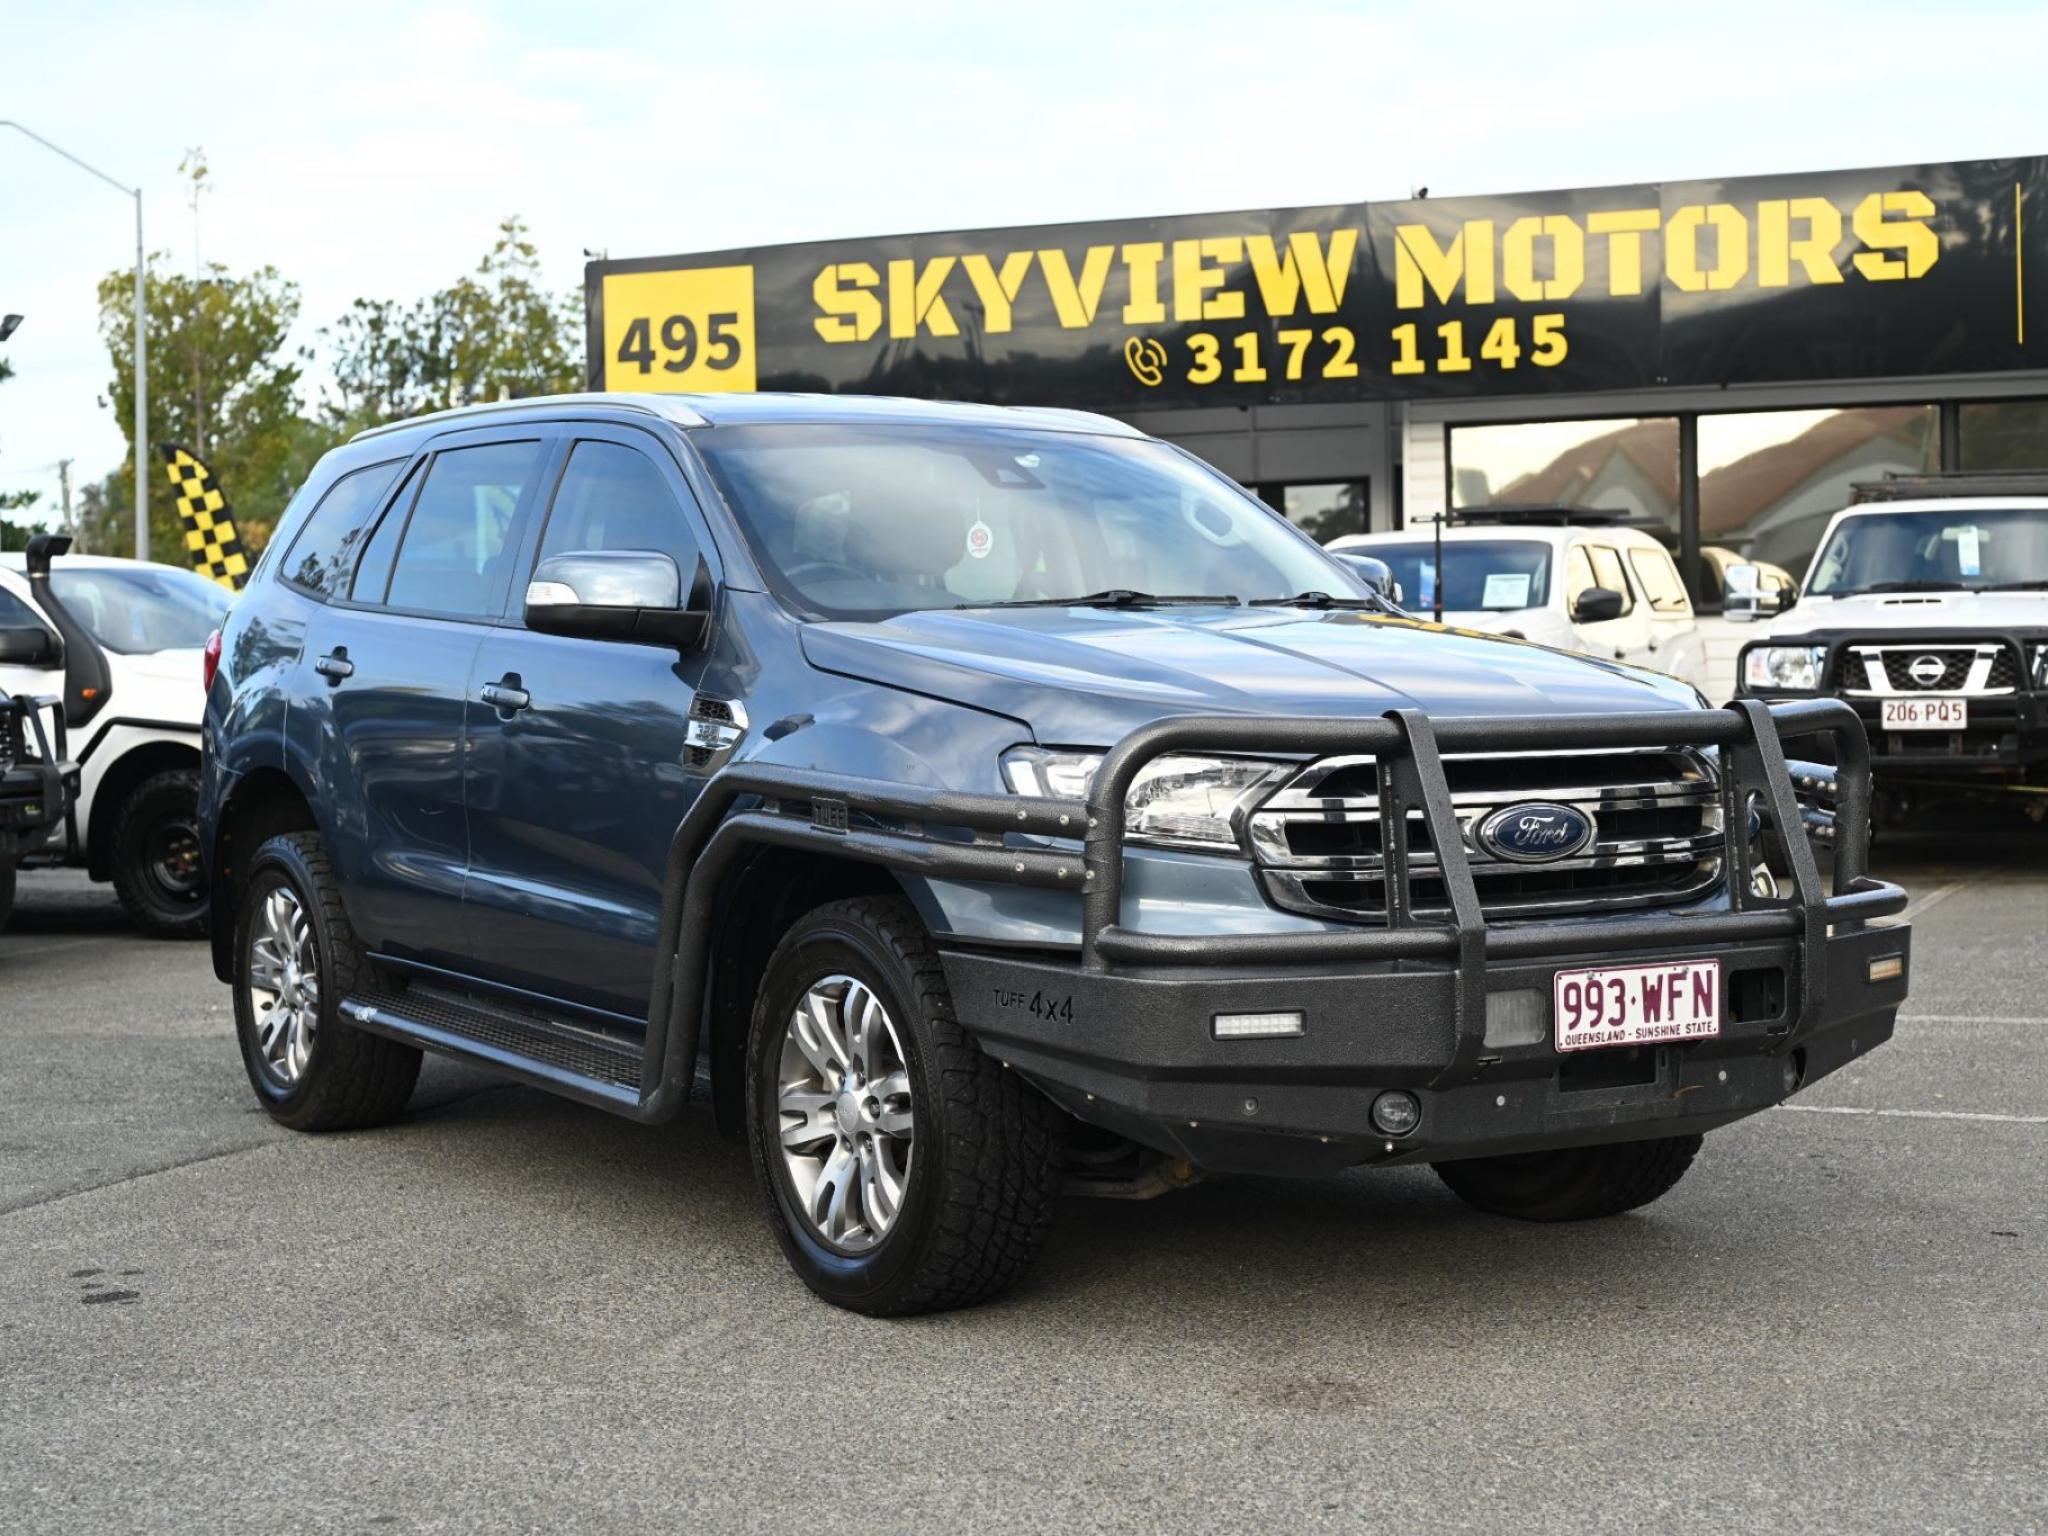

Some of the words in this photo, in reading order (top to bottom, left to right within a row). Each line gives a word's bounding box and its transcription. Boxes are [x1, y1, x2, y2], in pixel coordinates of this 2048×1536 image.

[812, 228, 1358, 343] SKYVIEW
[1394, 189, 1940, 310] MOTORS
[616, 311, 742, 375] 495
[1186, 326, 1359, 385] 3172
[1391, 313, 1569, 375] 1145
[1514, 816, 1569, 846] Ford
[993, 988, 1025, 1009] TUFF
[1564, 1031, 1626, 1047] QUEENSLAND
[1635, 1023, 1681, 1040] SUNSHINE
[1685, 1020, 1713, 1035] STATE
